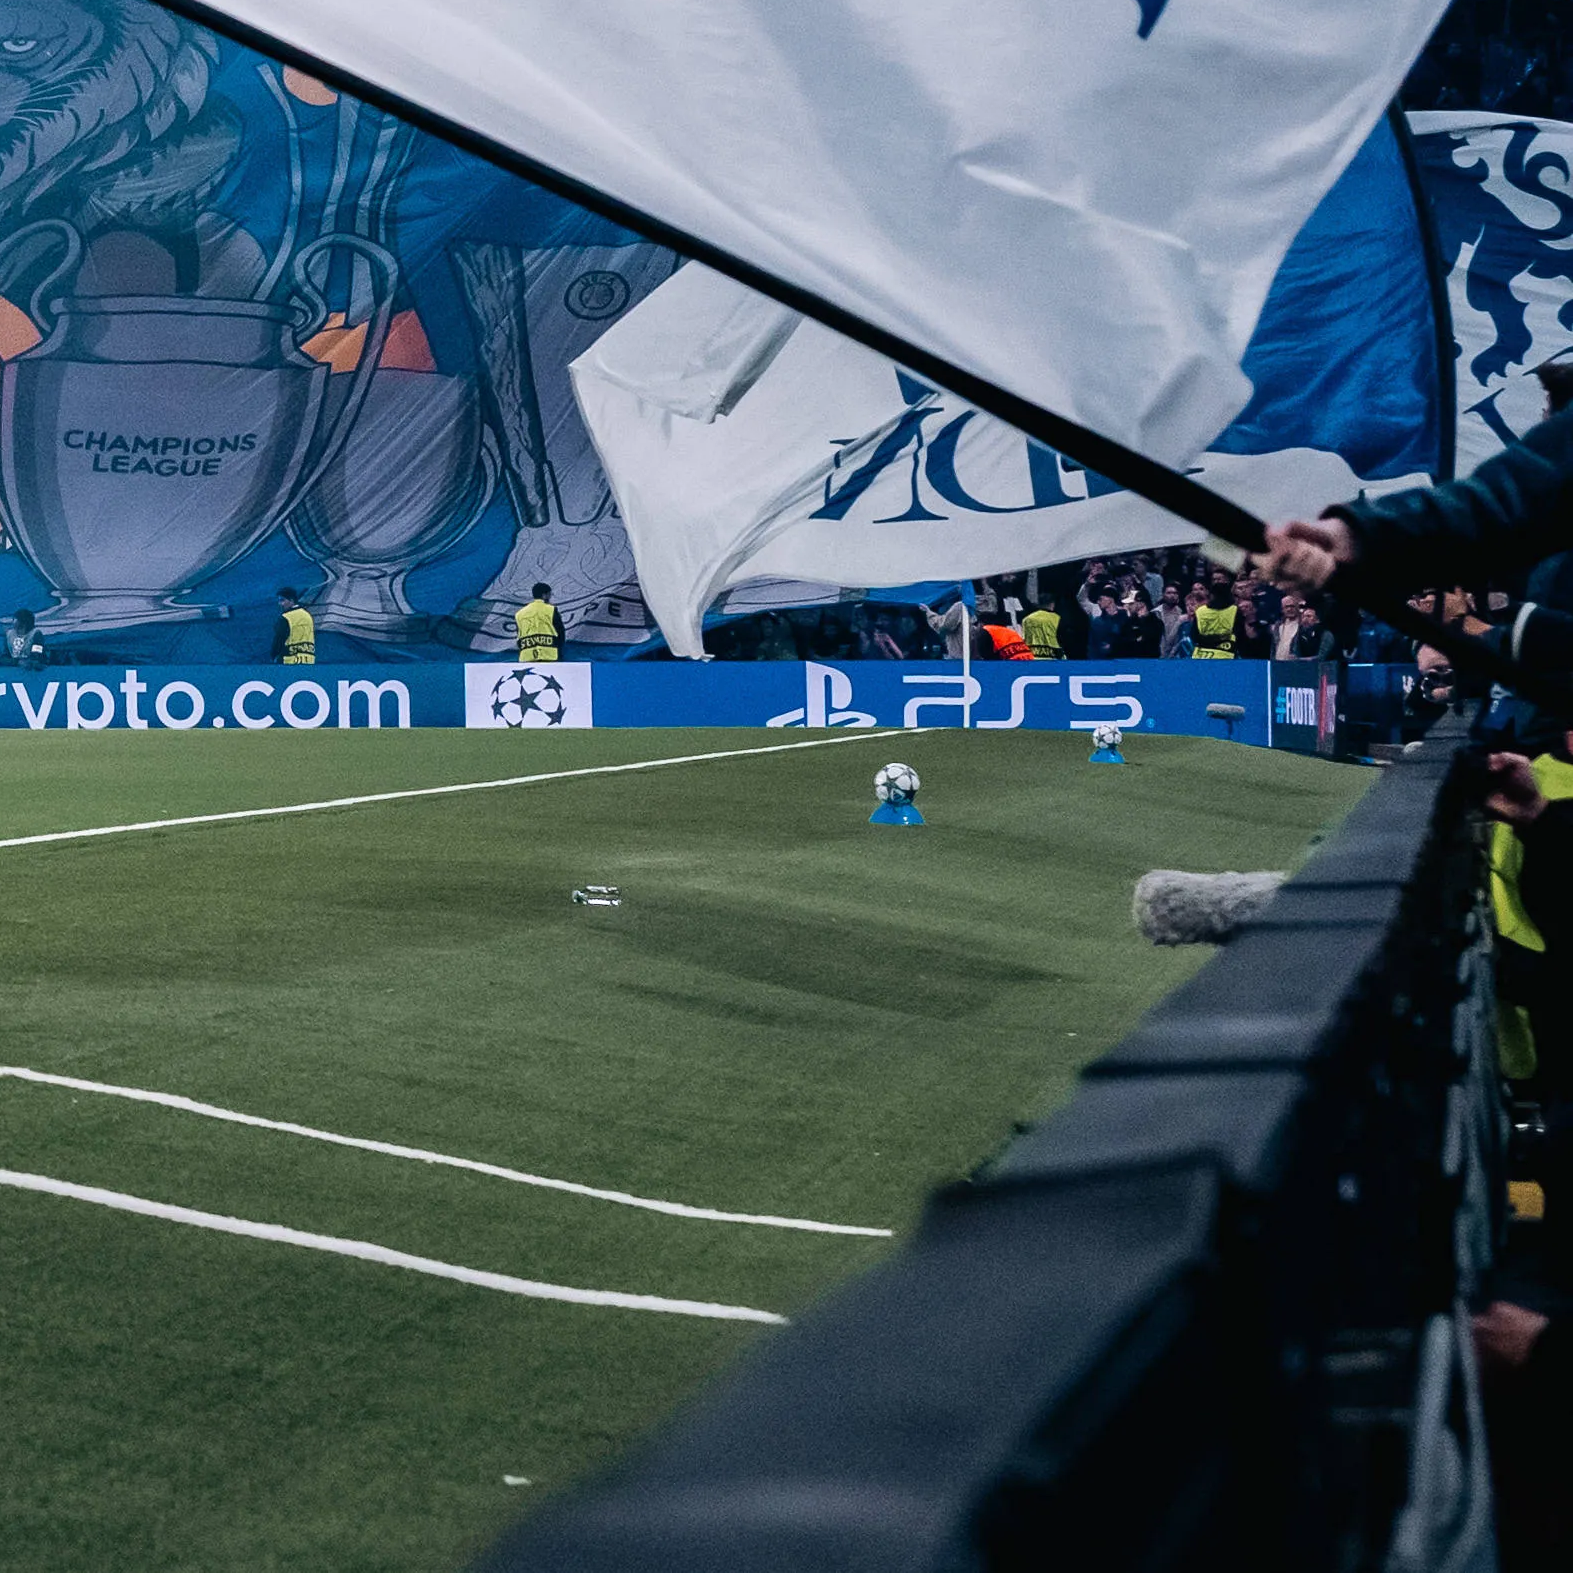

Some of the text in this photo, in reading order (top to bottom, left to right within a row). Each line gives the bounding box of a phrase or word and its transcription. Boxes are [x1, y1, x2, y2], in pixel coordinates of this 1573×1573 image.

[64, 429, 256, 455] CHAMPIONS
[92, 453, 223, 477] LEAGUE
[902, 674, 1144, 729] PS5
